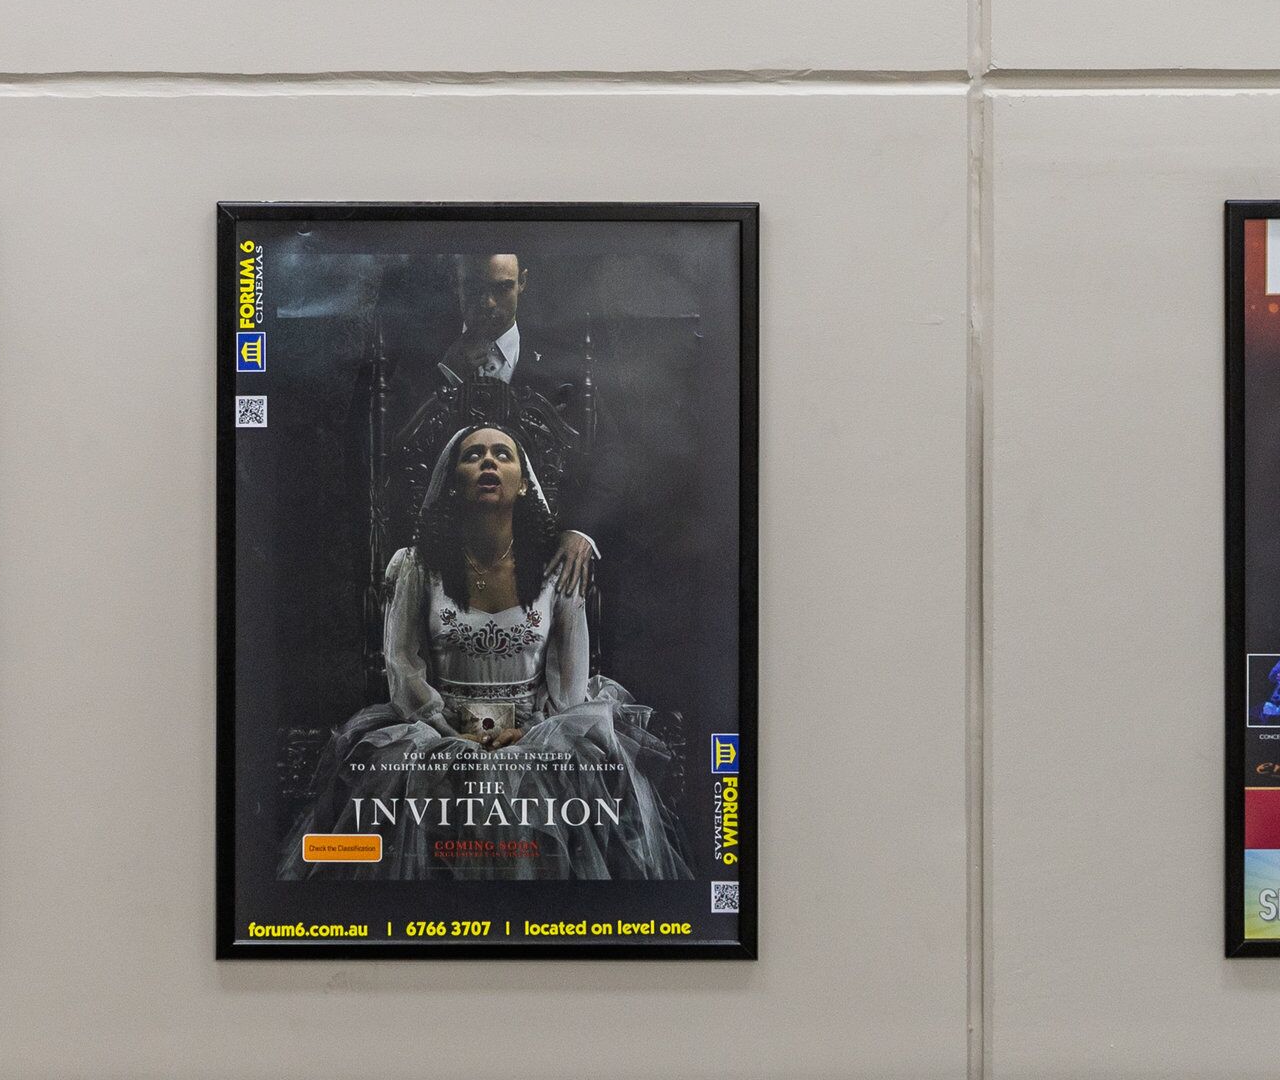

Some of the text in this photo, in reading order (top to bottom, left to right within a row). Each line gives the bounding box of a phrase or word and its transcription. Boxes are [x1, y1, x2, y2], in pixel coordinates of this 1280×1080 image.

[239, 240, 255, 329] FORUM 6
[255, 245, 264, 324] CINEMAS
[403, 752, 572, 761] YOU ARE CORDIALLY INVITED
[464, 781, 505, 794] THE
[352, 797, 622, 830] INVITATION
[248, 919, 692, 937] forum6.com.au 6766 3707 located on level one
